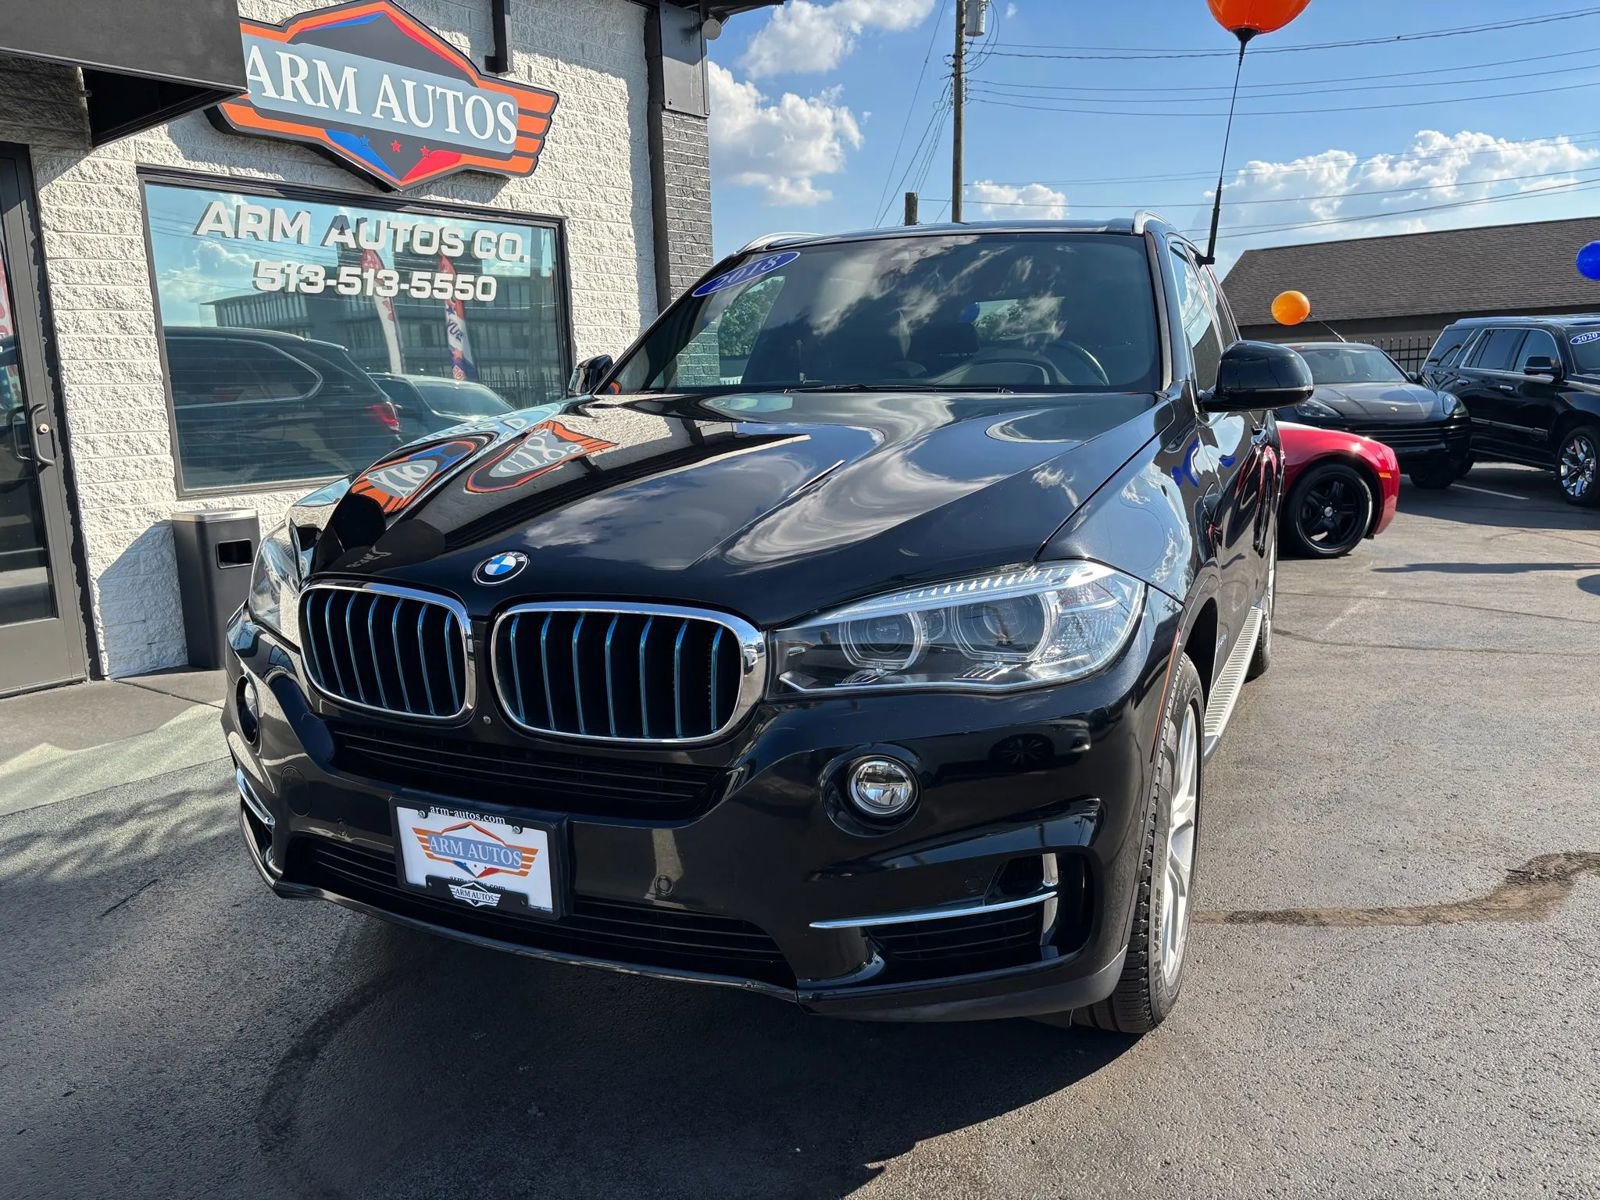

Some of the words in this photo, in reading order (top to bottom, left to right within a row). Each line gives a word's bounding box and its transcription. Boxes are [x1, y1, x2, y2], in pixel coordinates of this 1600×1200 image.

[246, 45, 362, 115] ARM
[372, 79, 518, 145] AUTOS
[196, 201, 311, 244] ARM
[324, 215, 465, 257] AUTOS
[473, 229, 529, 263] CO.
[253, 261, 498, 301] 513-513-5550
[711, 256, 781, 291] 2018
[429, 806, 506, 824] arm-autos.com
[430, 836, 465, 856] ARM
[468, 844, 523, 867] AUTOS
[456, 888, 471, 898] ARM
[472, 892, 495, 901] AUTOS
